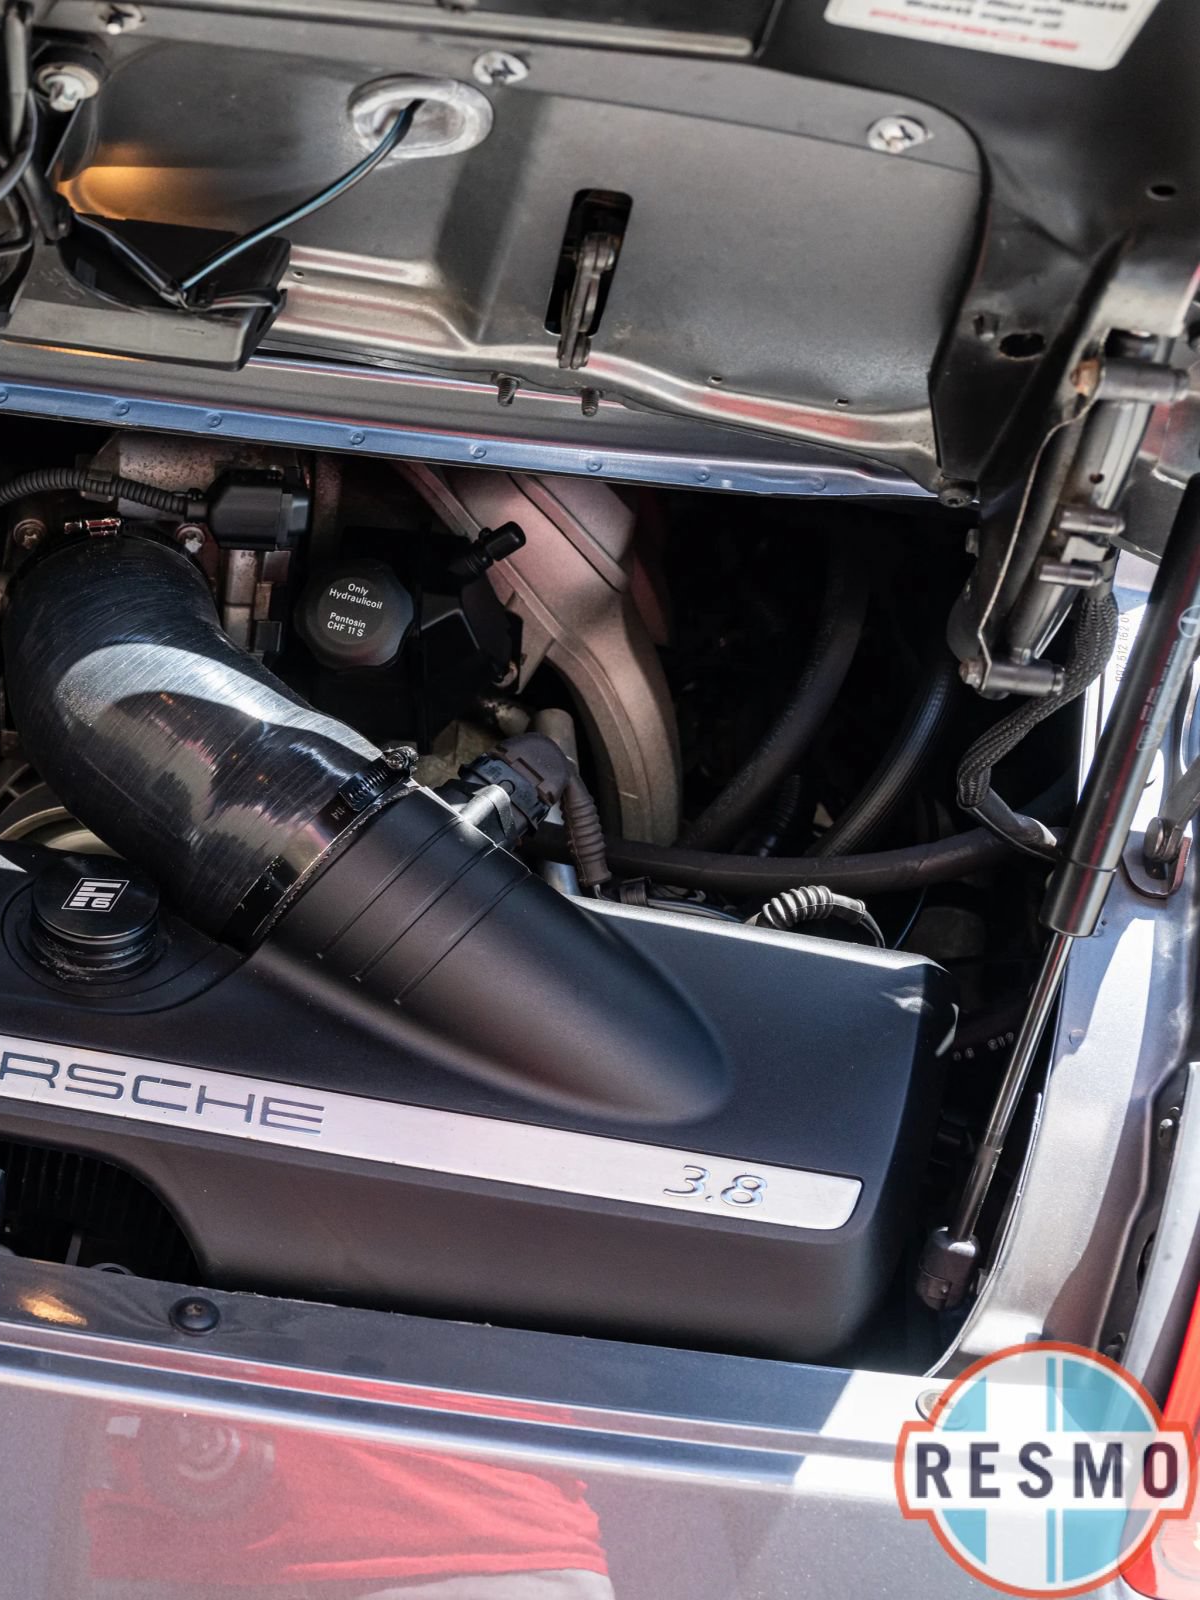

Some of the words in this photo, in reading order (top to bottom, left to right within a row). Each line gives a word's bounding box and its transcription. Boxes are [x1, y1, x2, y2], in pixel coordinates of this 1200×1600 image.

[328, 587, 383, 609] Hydraulicoil
[347, 583, 369, 597] Only
[329, 611, 366, 628] Pentosin
[327, 620, 346, 632] CHF
[347, 625, 356, 635] 11
[356, 628, 365, 637] S
[662, 1164, 768, 1208] 3.8
